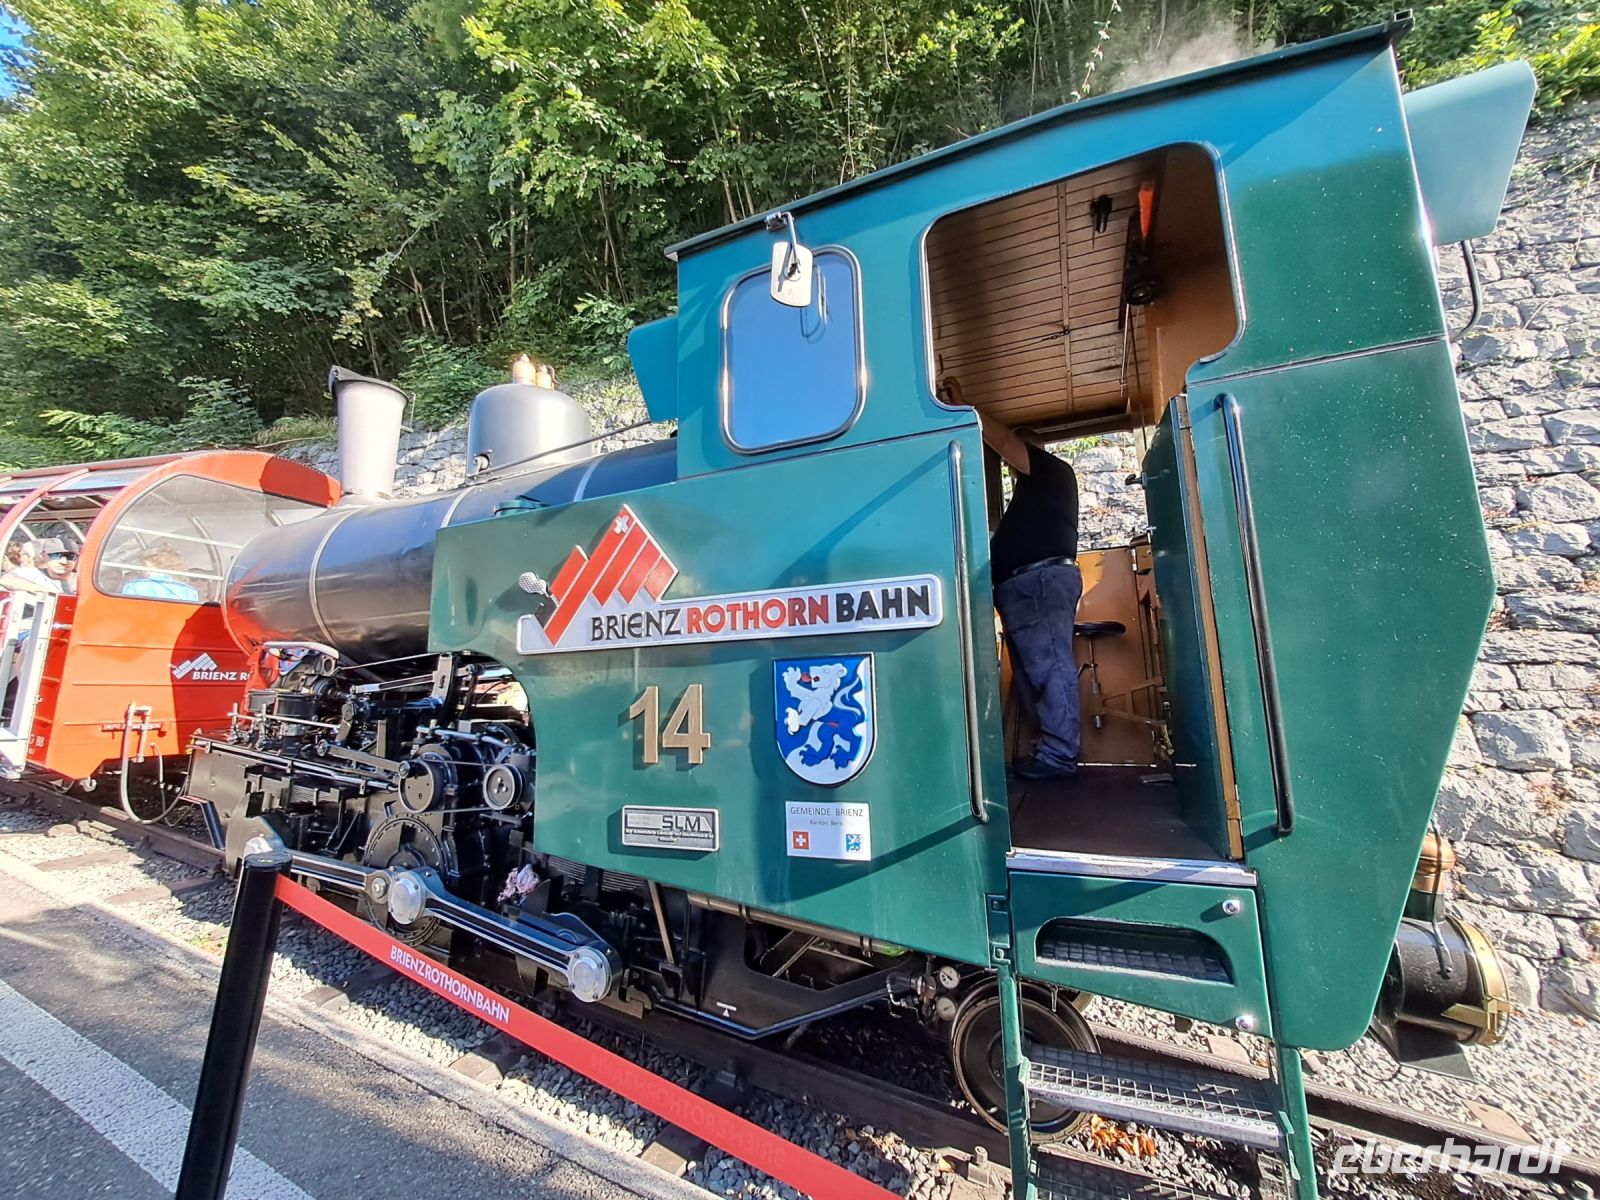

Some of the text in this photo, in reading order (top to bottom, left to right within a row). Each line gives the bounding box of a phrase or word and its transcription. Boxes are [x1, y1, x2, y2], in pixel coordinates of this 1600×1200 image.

[591, 584, 931, 641] BRIENZ ROTHORN BAHN
[192, 671, 237, 681] BRIENZ
[629, 683, 711, 764] 14
[661, 815, 701, 832] SLM
[790, 806, 864, 817] GEMEINDE BRIENZ
[390, 945, 510, 1024] BRIENZROTHORNBAHN
